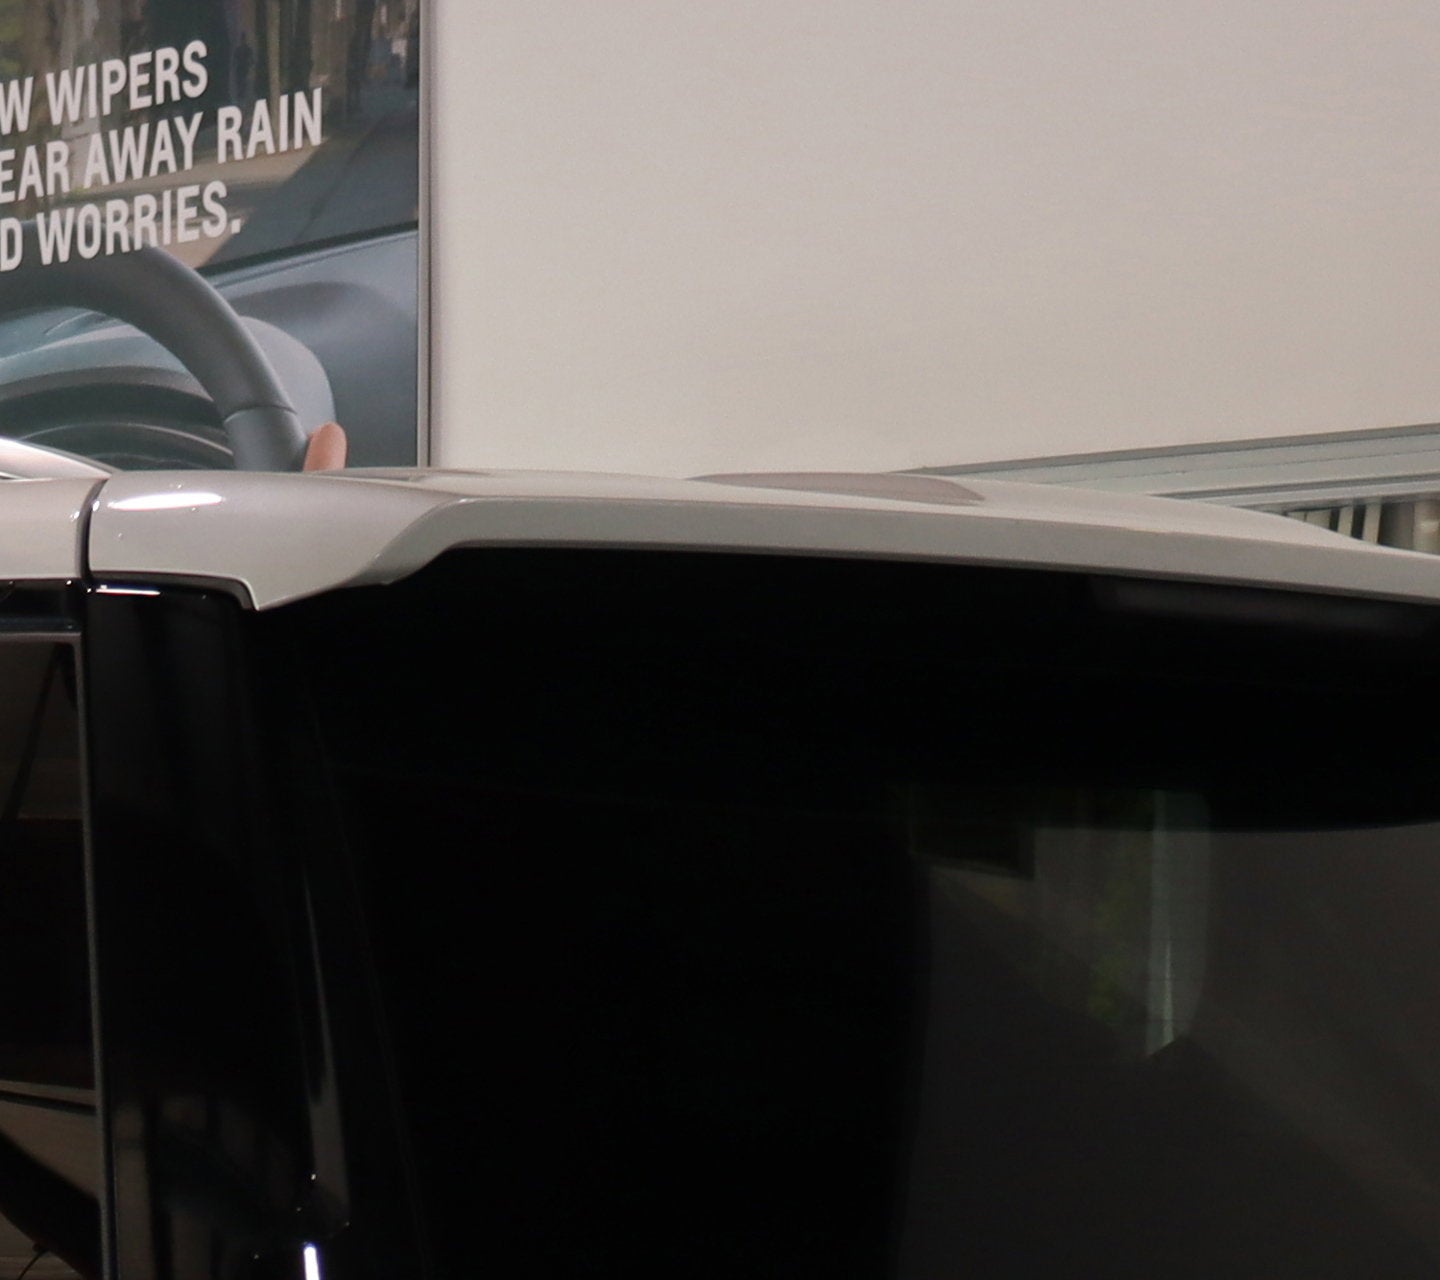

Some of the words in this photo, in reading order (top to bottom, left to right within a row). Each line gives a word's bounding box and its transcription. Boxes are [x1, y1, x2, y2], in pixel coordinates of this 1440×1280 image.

[46, 39, 208, 126] WIPERS
[83, 112, 203, 189] AWAY
[217, 87, 323, 164] RAIN
[36, 180, 242, 266] WORRIES.
